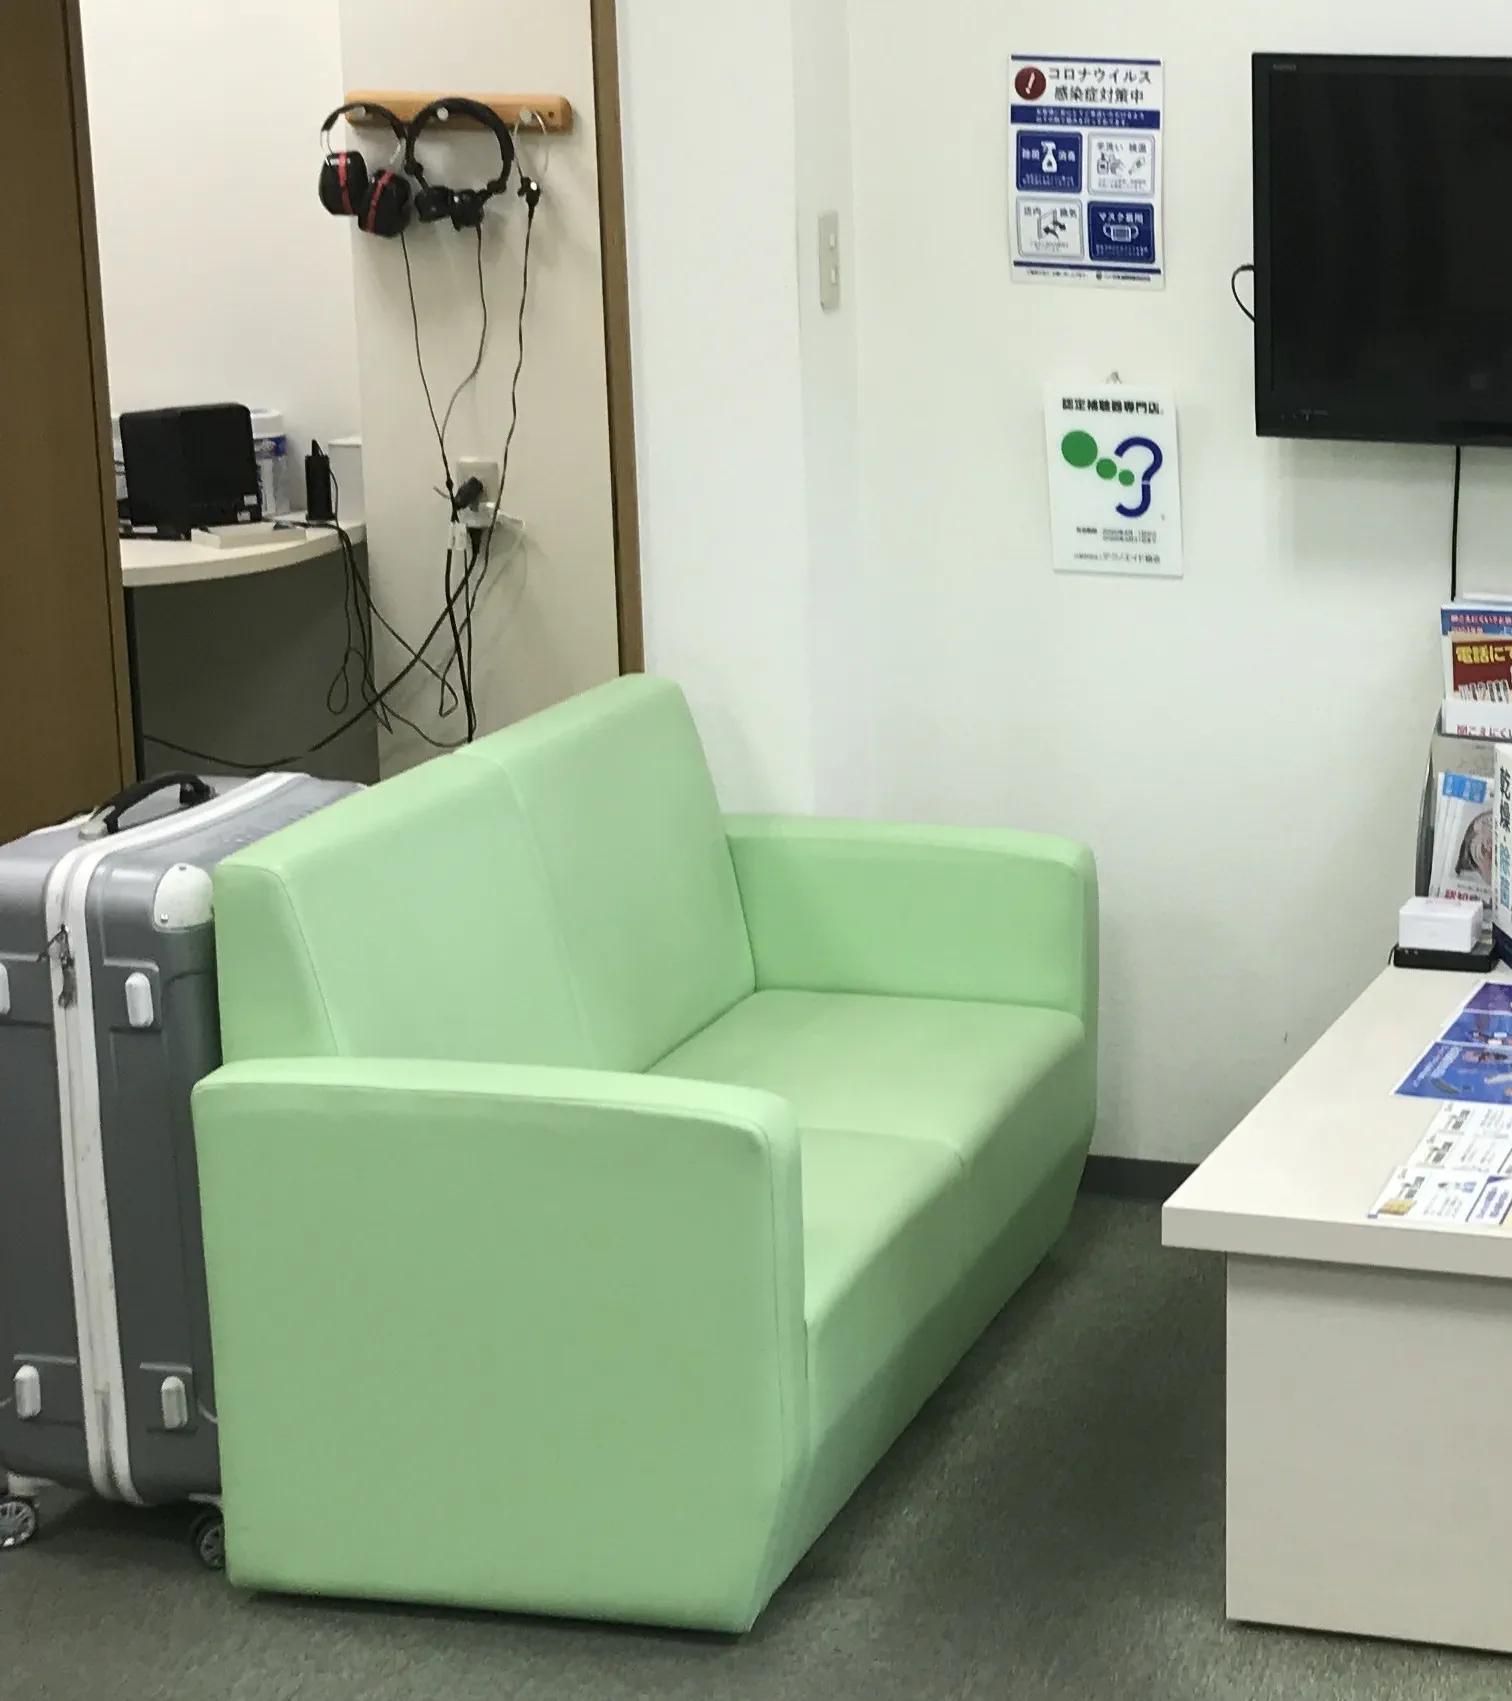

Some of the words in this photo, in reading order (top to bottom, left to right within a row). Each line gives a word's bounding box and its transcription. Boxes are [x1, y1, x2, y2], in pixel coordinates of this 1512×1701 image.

[1048, 67, 1151, 84] コロナウイルス
[1054, 85, 1144, 104] 感染症対策中
